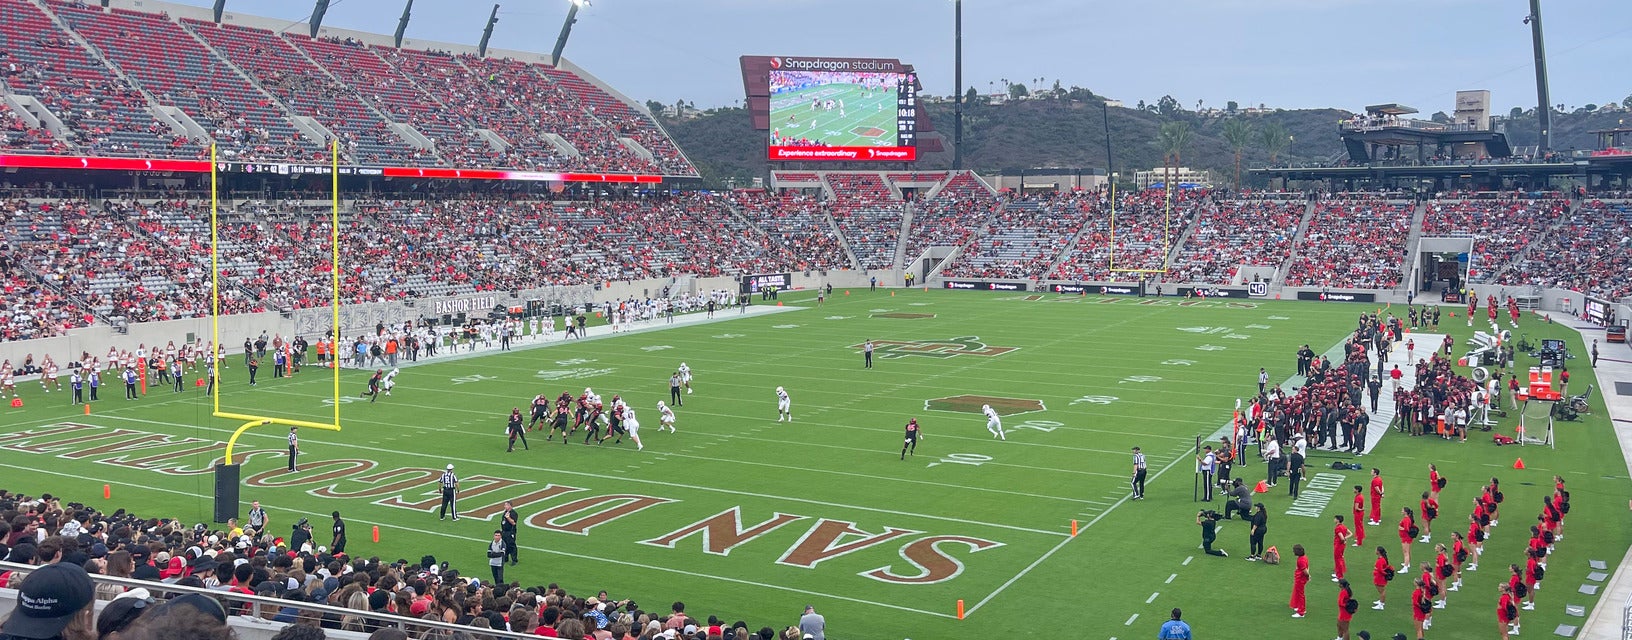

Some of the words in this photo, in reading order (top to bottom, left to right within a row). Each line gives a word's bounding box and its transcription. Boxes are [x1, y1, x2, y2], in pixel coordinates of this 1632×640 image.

[785, 57, 850, 72] Snapdragon
[852, 59, 895, 71] stadium
[898, 108, 915, 117] 10:18
[777, 149, 813, 157] Experience
[953, 281, 975, 289] Snapdragon
[1251, 284, 1266, 295] 40
[1327, 293, 1354, 301] Snapdragon
[436, 299, 469, 314] BASHOR
[472, 297, 495, 310] FIELD
[939, 453, 994, 467] 10
[241, 459, 684, 536] DIEGO
[635, 505, 1008, 585] SAN
[36, 597, 58, 605] Alpha
